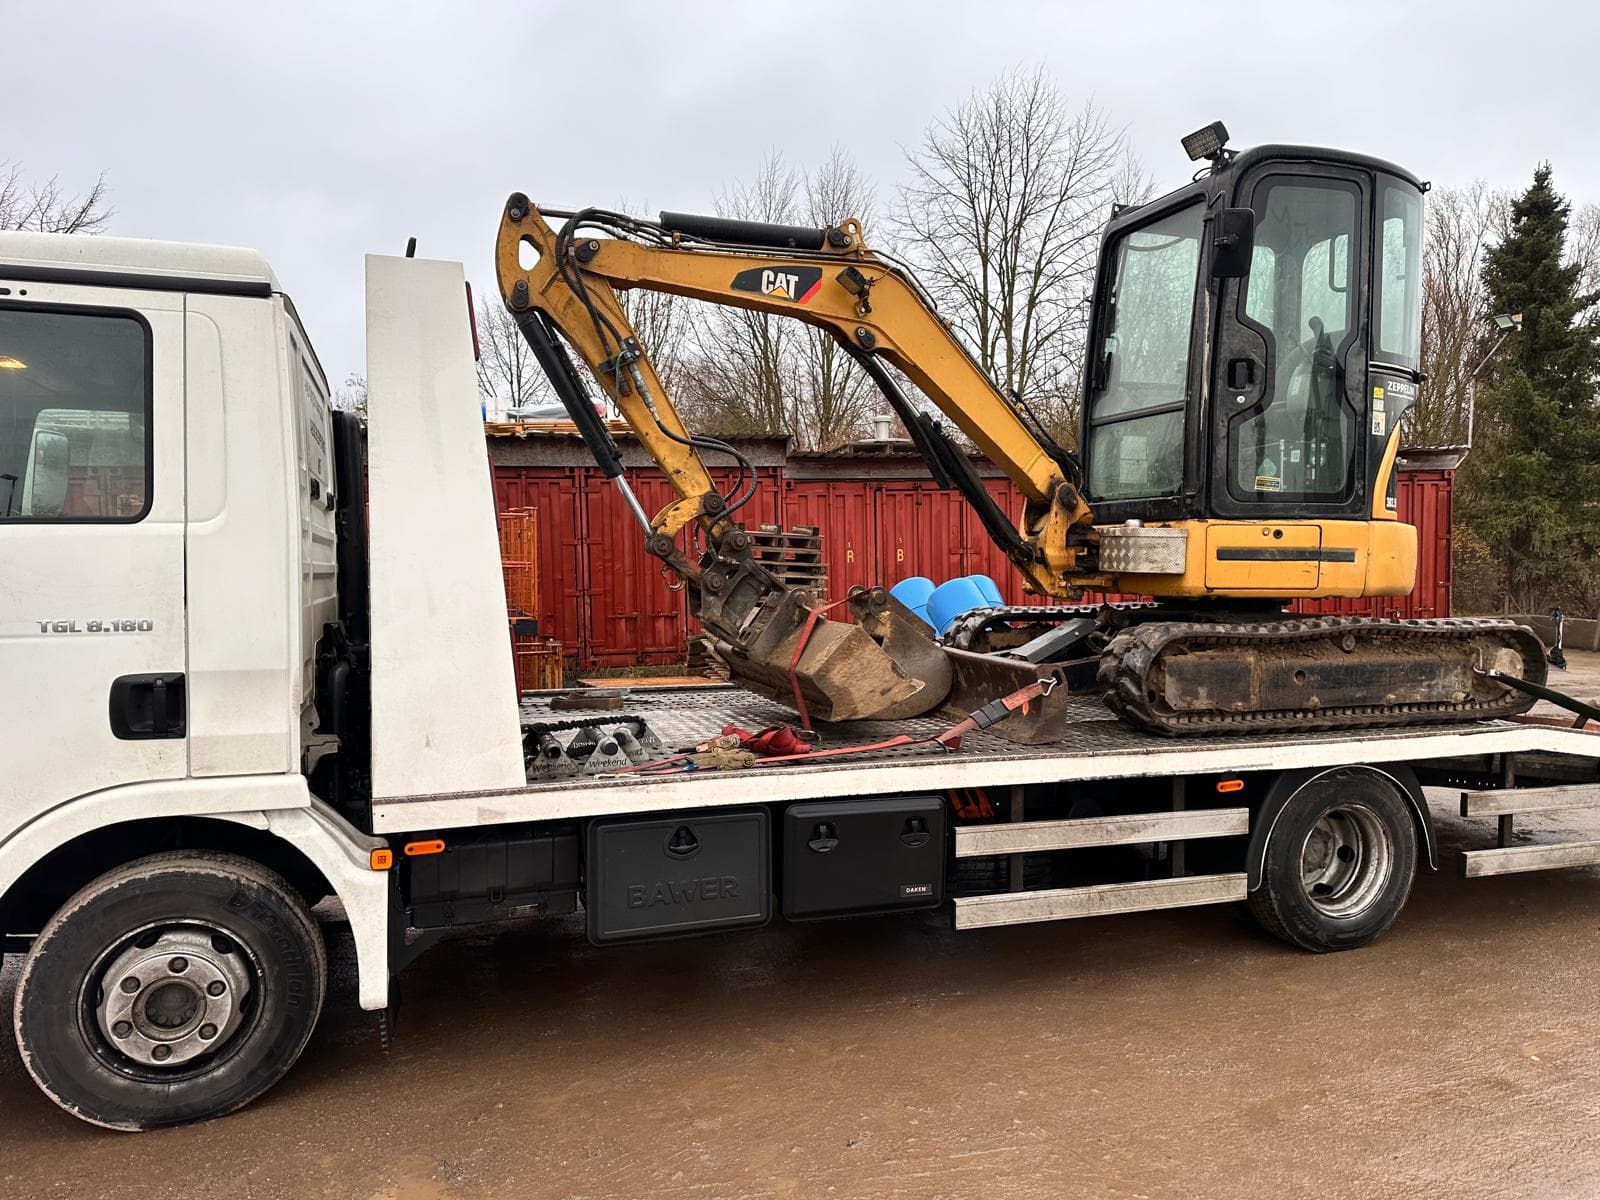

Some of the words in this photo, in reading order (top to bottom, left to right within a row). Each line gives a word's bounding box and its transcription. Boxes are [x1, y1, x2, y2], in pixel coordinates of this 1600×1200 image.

[761, 270, 799, 299] CAT
[847, 550, 854, 563] R
[896, 548, 904, 561] B
[37, 619, 82, 633] TGL
[87, 619, 153, 632] 8.180
[589, 758, 627, 768] Weekend
[627, 876, 738, 909] BAWER
